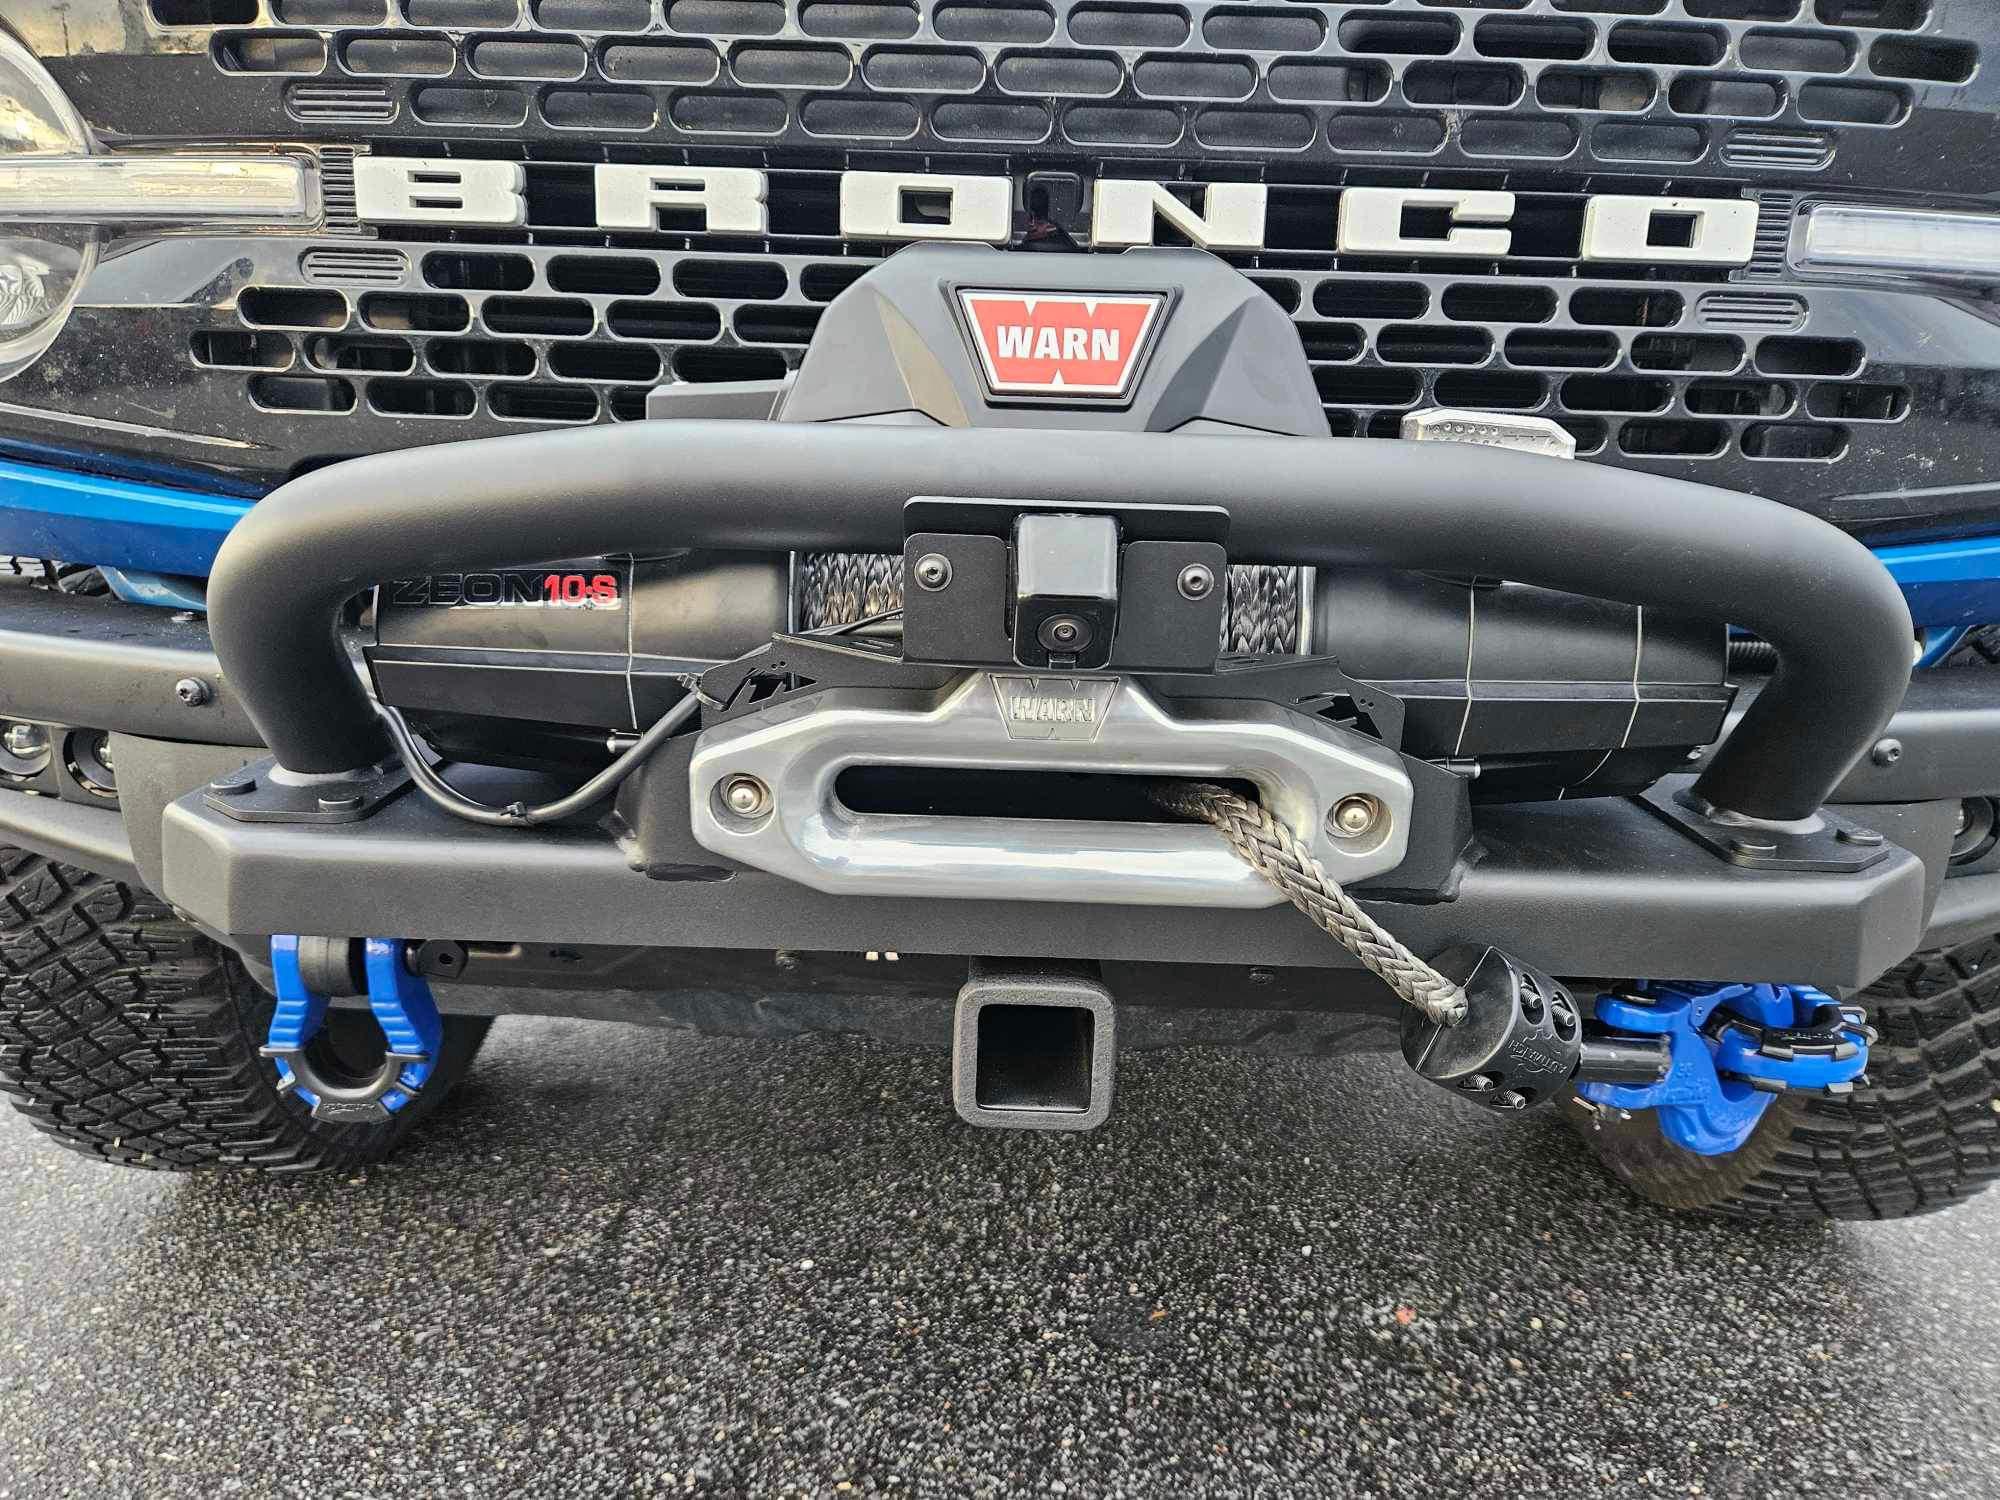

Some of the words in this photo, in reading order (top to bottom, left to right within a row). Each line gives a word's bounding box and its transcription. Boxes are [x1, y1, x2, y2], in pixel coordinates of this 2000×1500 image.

[353, 155, 1759, 265] BRONCO
[996, 325, 1120, 361] WARN
[392, 573, 545, 606] ZEON
[1010, 695, 1096, 722] WARN
